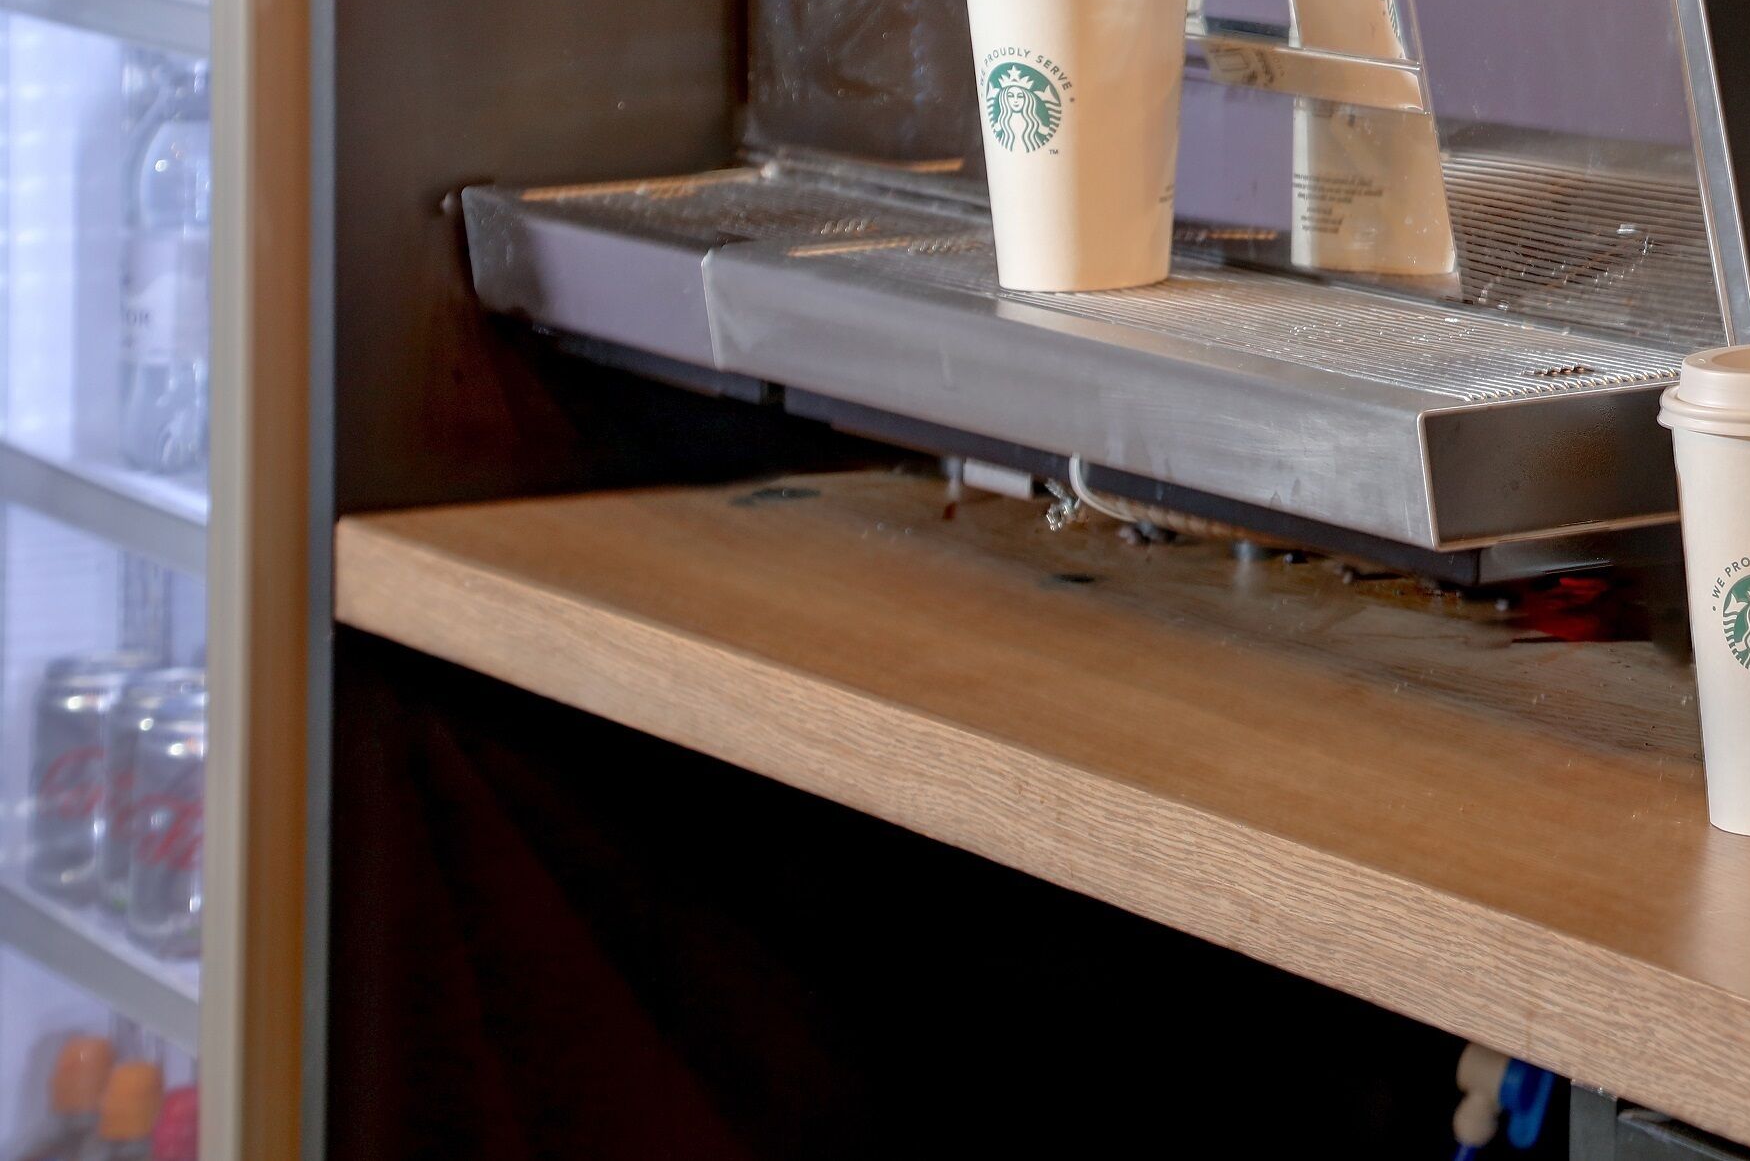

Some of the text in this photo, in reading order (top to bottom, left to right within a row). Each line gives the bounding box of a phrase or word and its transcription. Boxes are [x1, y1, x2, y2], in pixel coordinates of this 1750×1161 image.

[983, 47, 1031, 67] PROUDLY
[1035, 55, 1073, 91] SERVE
[1712, 577, 1725, 599] WE
